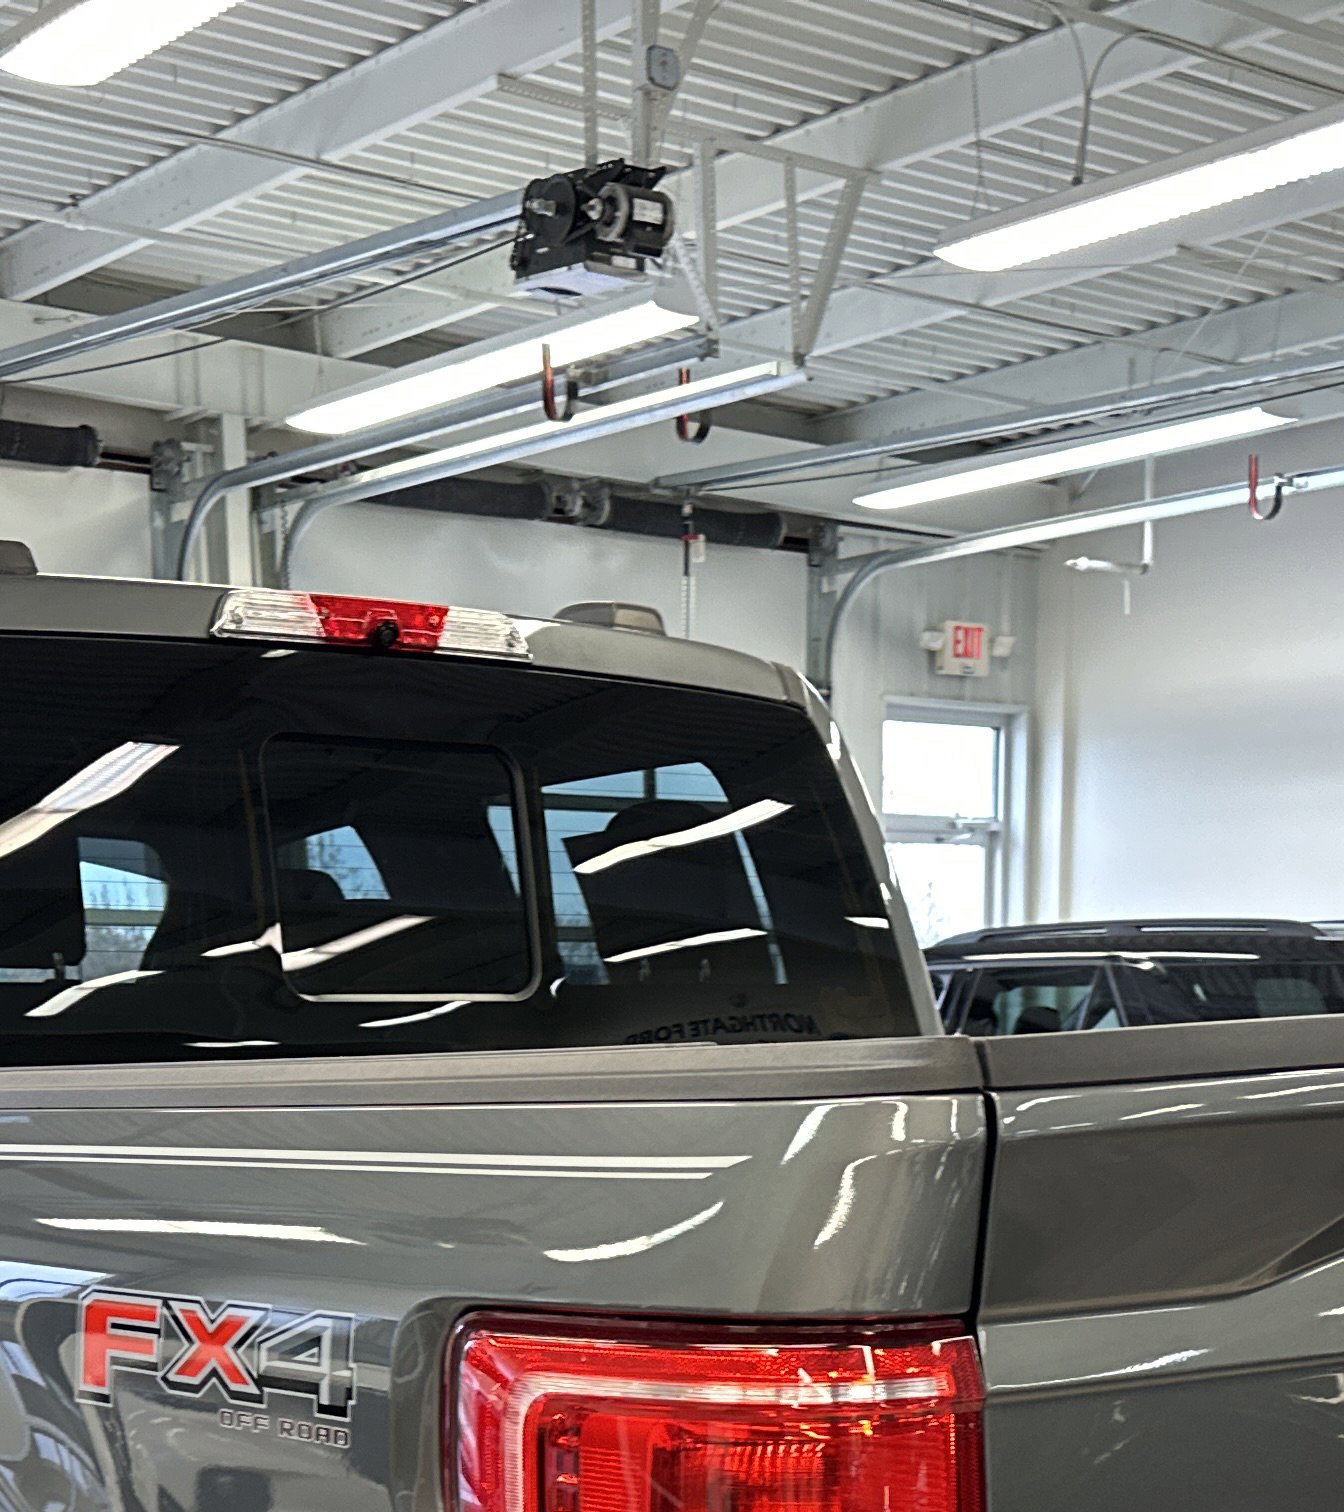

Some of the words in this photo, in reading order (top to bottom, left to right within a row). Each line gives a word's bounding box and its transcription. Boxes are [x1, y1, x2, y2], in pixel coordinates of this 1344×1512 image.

[952, 625, 984, 660] EXIT
[75, 1285, 356, 1422] FX4
[218, 1407, 270, 1433] OFF
[277, 1416, 352, 1449] ROAD
